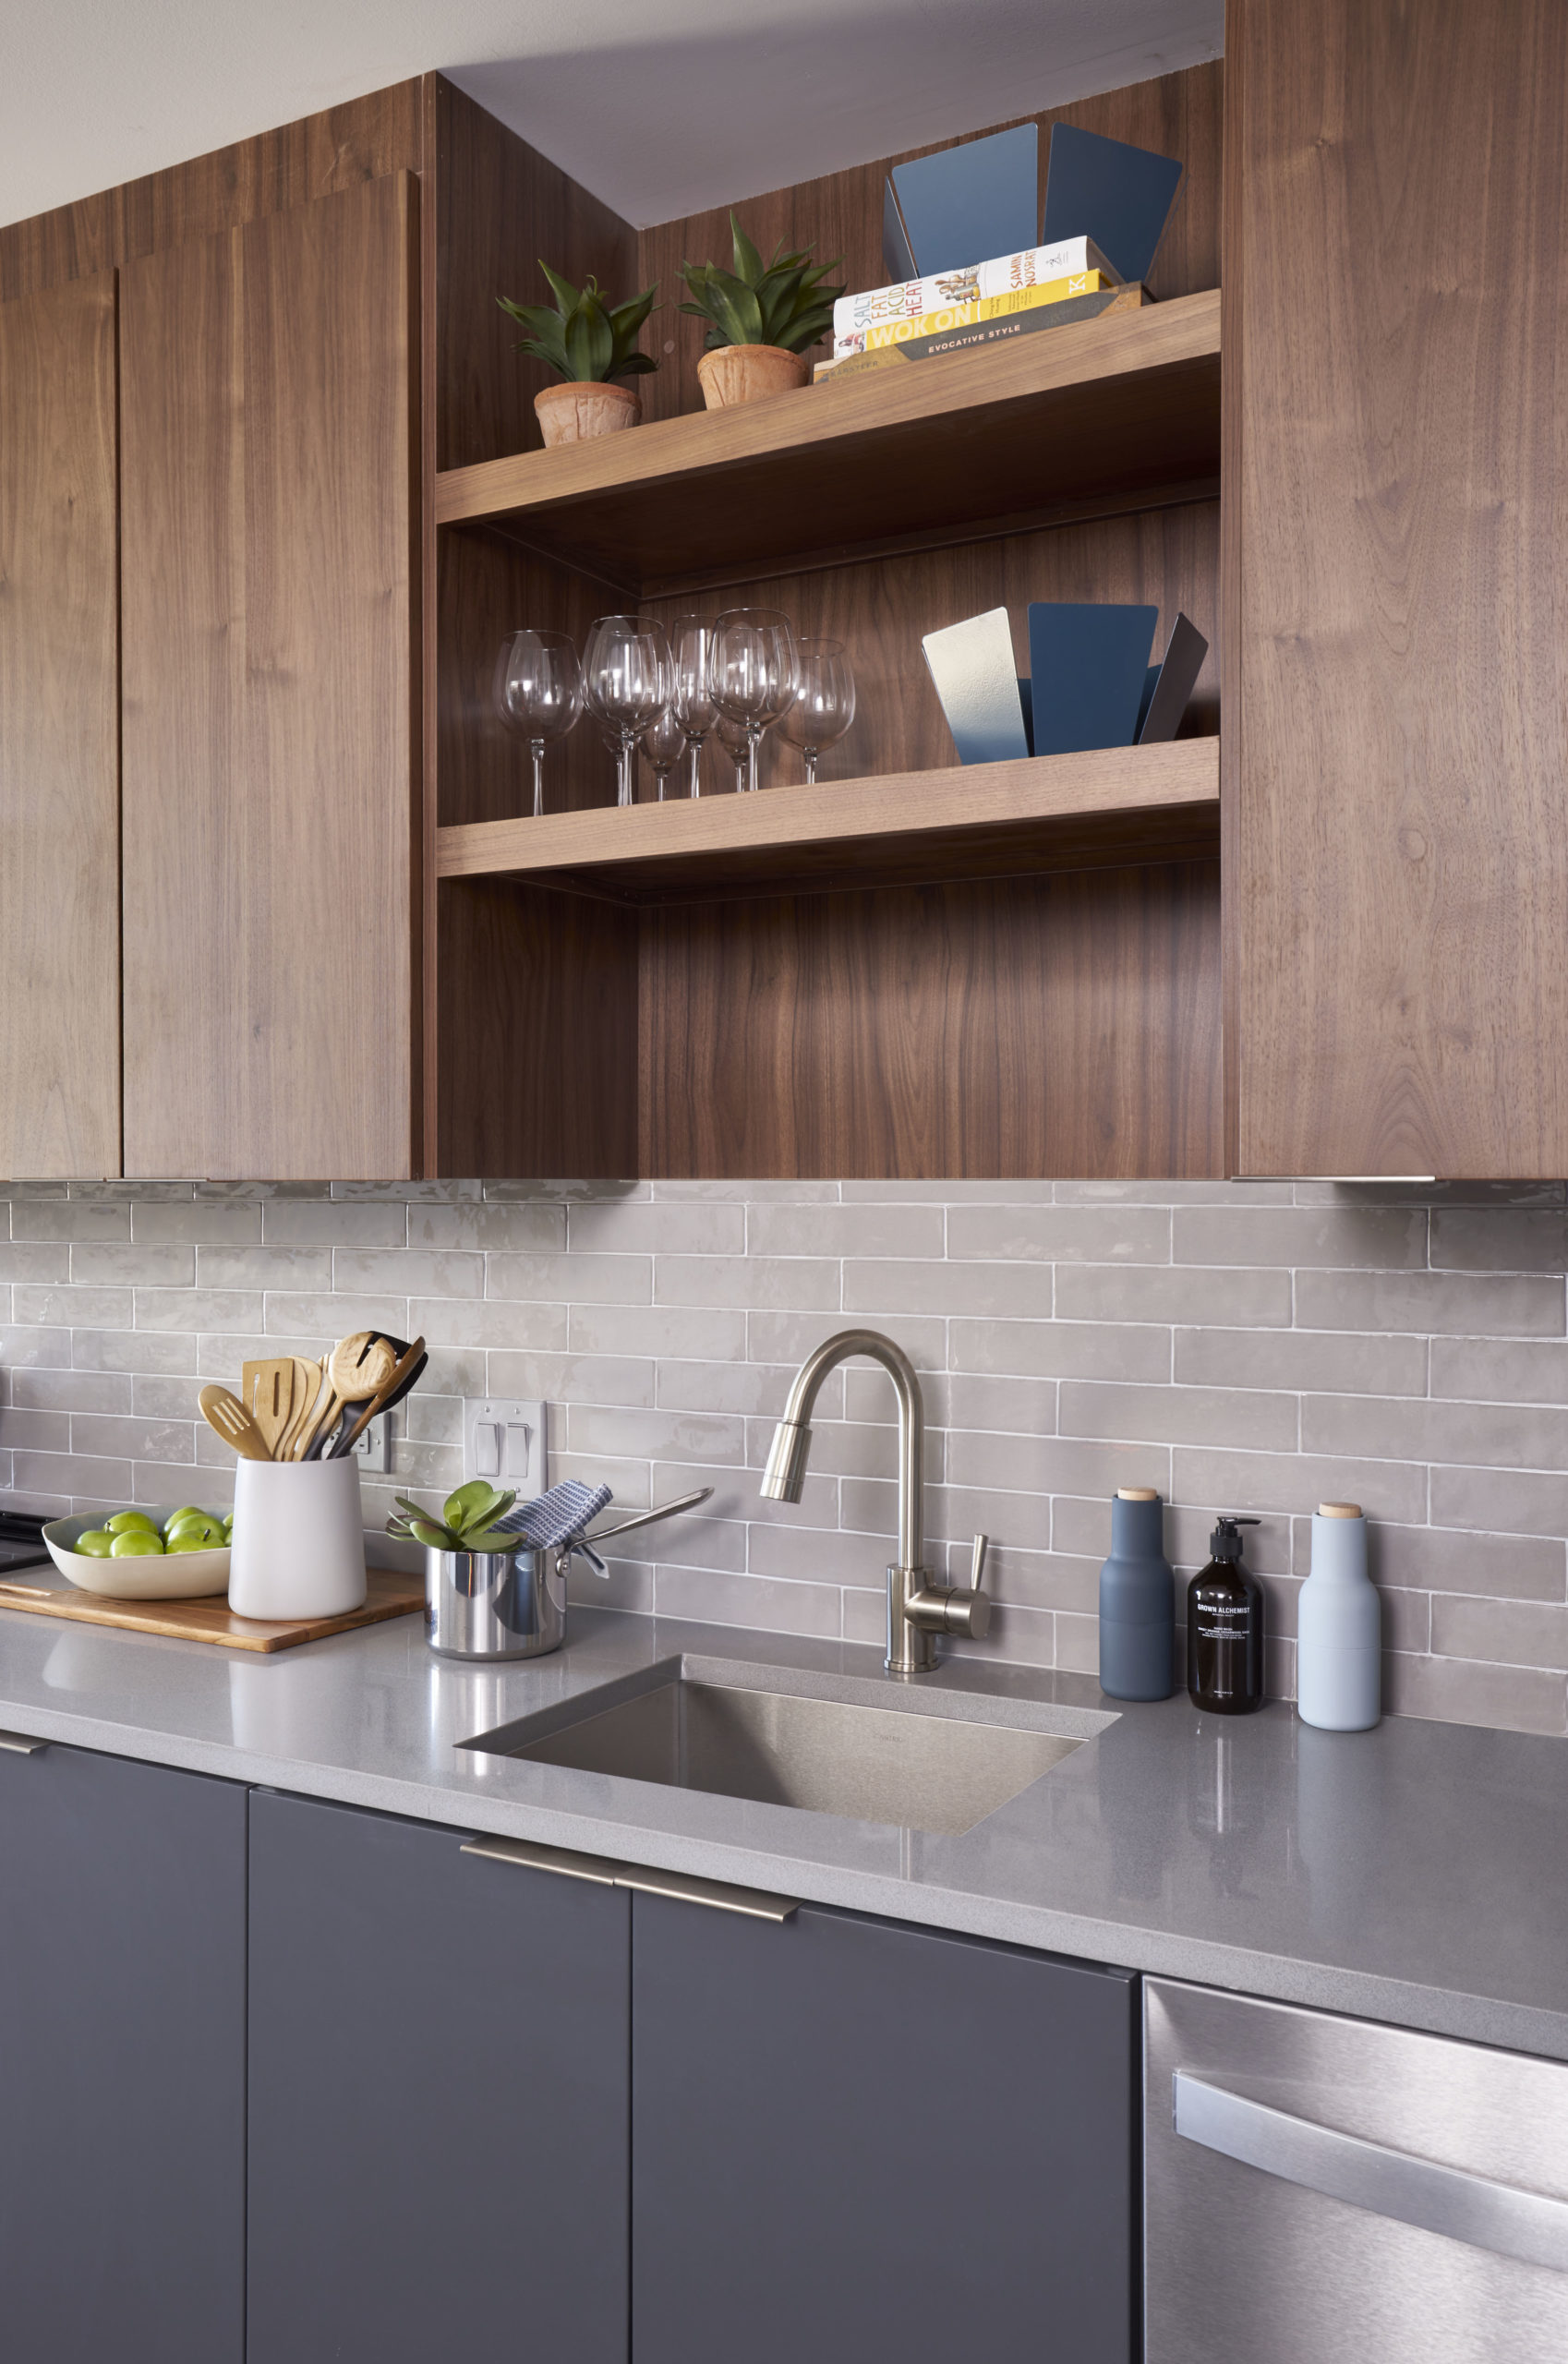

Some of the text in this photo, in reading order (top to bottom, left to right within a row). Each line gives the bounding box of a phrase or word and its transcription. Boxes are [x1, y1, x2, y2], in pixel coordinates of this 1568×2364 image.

[1010, 255, 1024, 289] SAMIN
[1024, 250, 1037, 288] NOSRAT
[1068, 274, 1086, 295] K
[853, 294, 872, 329] SALT
[871, 294, 888, 320] FAT
[887, 286, 906, 316] ACID
[906, 280, 923, 318] HEAT
[871, 304, 971, 348] WOK ON
[928, 324, 1020, 354] EVOCATIVE STYLE
[1198, 1603, 1217, 1613] GROWN
